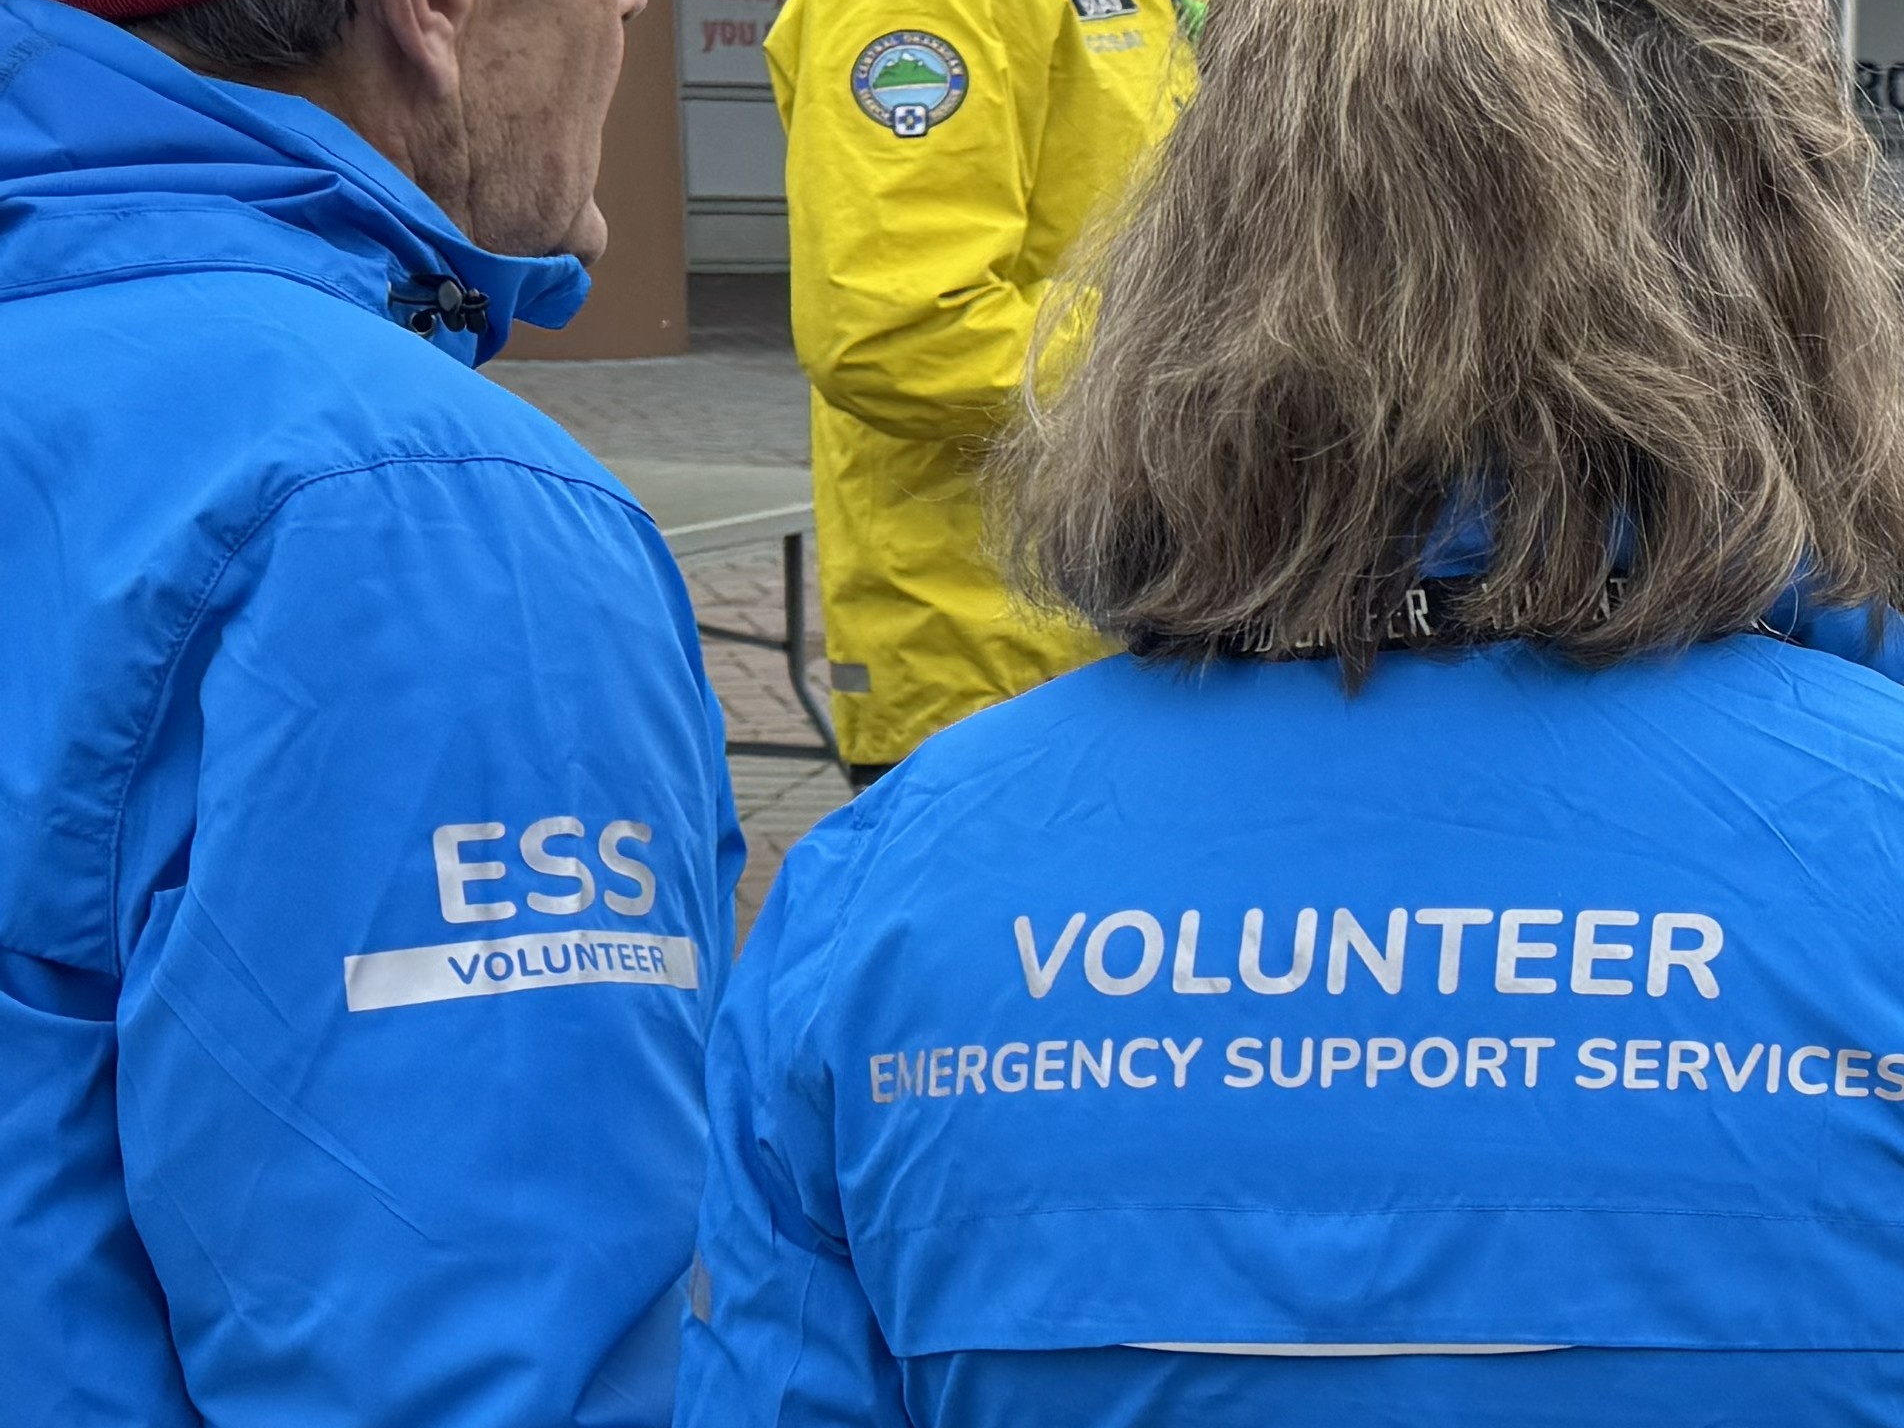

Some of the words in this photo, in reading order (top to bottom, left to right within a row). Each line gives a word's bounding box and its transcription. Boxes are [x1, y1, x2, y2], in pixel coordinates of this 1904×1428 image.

[703, 18, 757, 52] you
[433, 816, 656, 923] ESS
[448, 942, 666, 985] VOLUNTEER
[1014, 907, 1724, 998] VOLUNTEER
[868, 1036, 1203, 1105] EMERGENCY
[1224, 1037, 1556, 1090] SUPPORT
